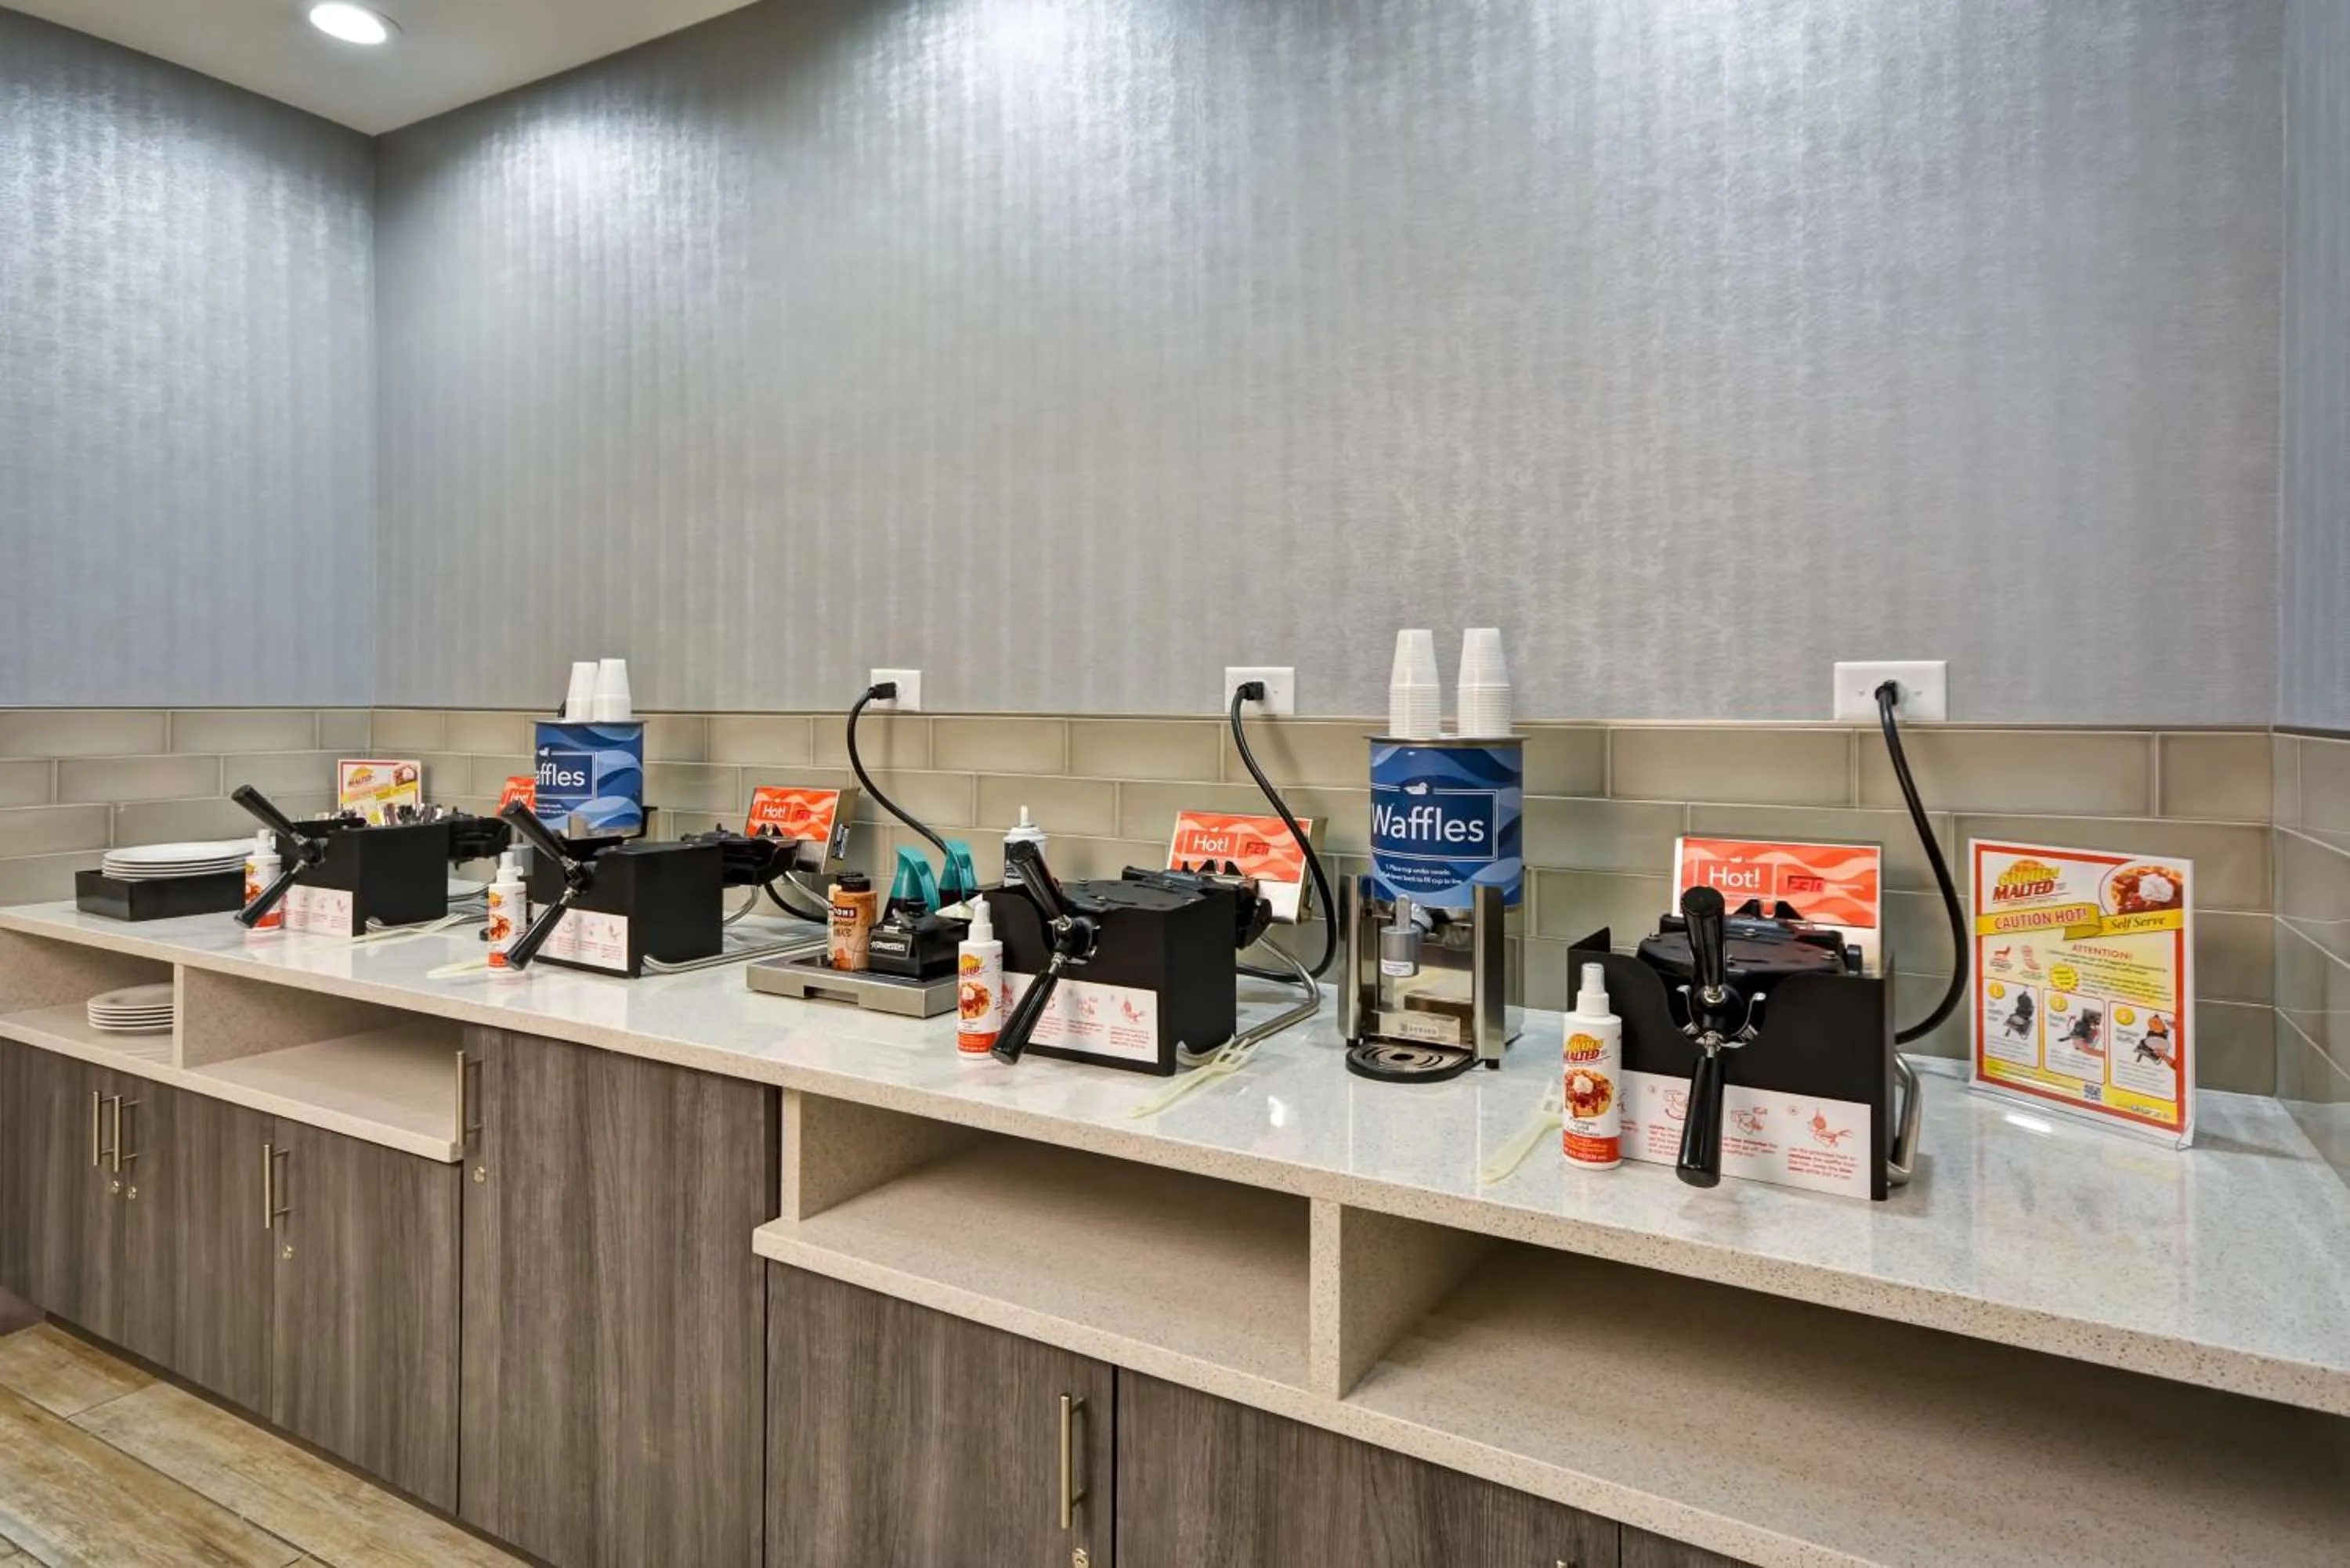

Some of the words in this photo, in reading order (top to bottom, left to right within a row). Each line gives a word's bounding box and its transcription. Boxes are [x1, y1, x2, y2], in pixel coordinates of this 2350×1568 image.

[535, 763, 585, 786] affles
[762, 804, 786, 818] Hot!
[1372, 801, 1484, 842] Waffles
[1193, 833, 1229, 853] Hot!
[1708, 865, 1761, 888] Hot!
[1993, 880, 2055, 901] MALTED
[1994, 912, 2052, 930] CAUTION
[2055, 908, 2088, 923] HOT!
[2110, 916, 2132, 930] Self
[2133, 916, 2166, 928] Serve
